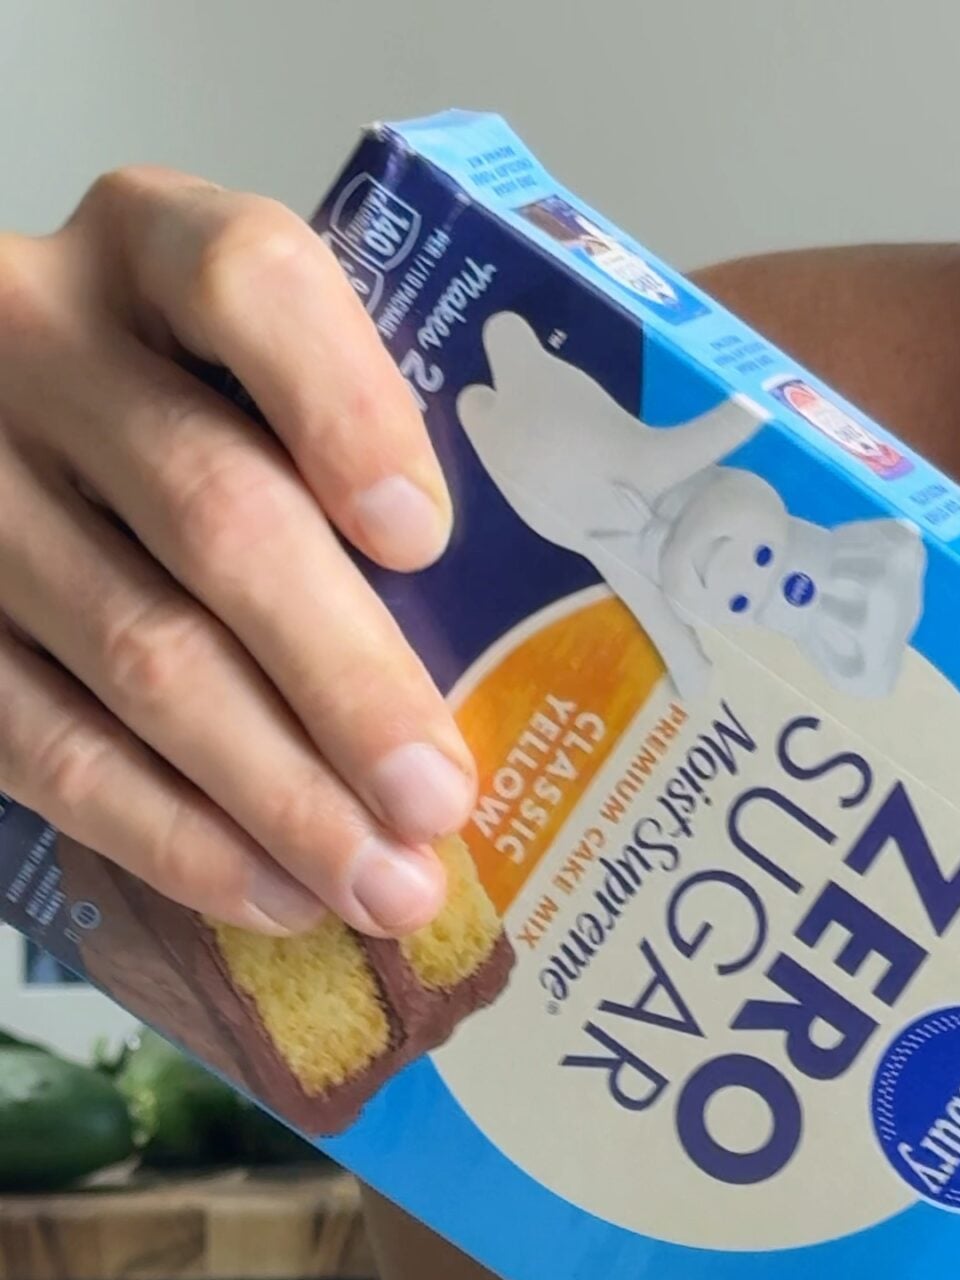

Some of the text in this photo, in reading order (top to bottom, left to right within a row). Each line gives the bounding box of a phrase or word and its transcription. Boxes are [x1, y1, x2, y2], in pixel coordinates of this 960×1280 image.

[361, 212, 412, 259] 140
[403, 253, 435, 288] 1/10
[416, 255, 496, 351] Makes
[421, 228, 451, 259] PER
[471, 693, 579, 839] YELLOW
[494, 711, 605, 865] CLASSIC
[516, 702, 688, 950] PREMIUM CAKE MIX
[656, 699, 759, 837] Moist
[559, 716, 874, 1111] SUGAR
